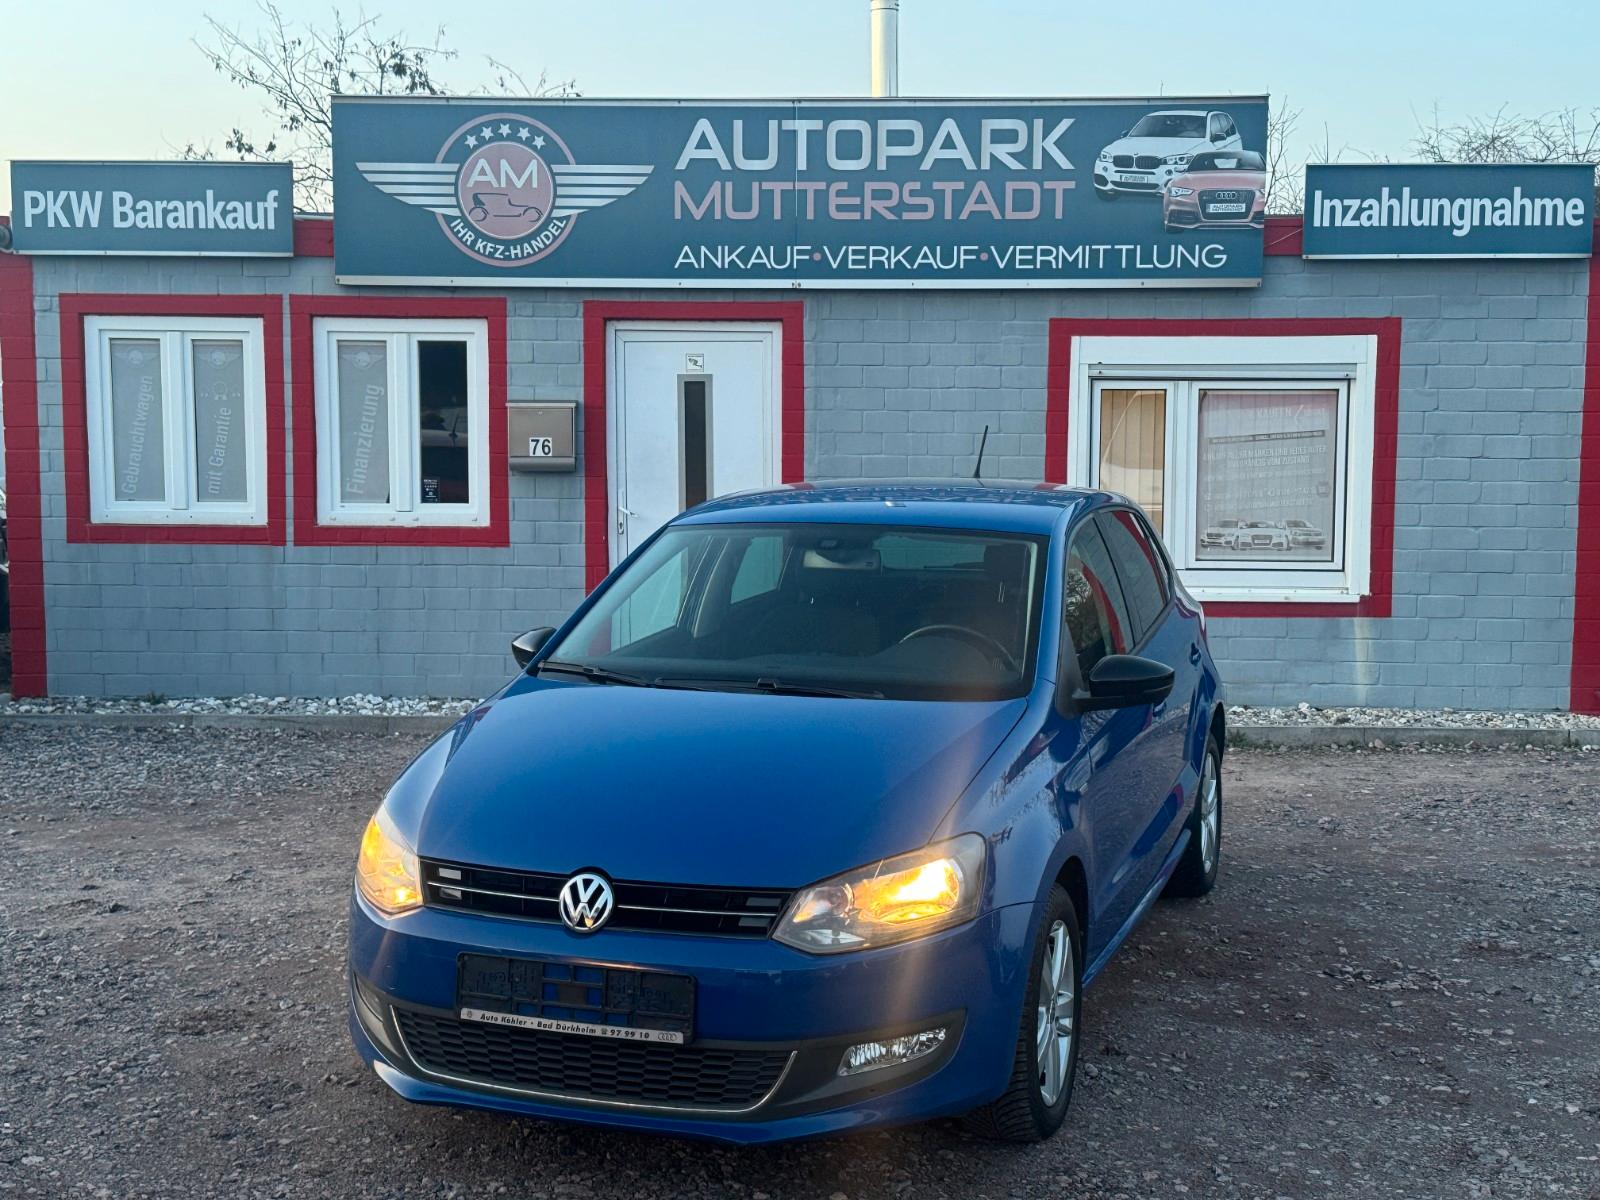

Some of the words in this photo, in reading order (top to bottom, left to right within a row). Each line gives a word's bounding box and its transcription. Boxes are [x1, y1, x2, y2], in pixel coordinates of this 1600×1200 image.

[674, 117, 1076, 171] AUTOPARK
[466, 158, 538, 189] AM
[23, 190, 103, 229] PKW
[112, 189, 279, 230] Barankauf
[673, 180, 1077, 220] MUTTERSTADT
[1312, 186, 1585, 237] Inzahlungnahme
[450, 218, 475, 246] IHR
[475, 218, 567, 259] KFZ-HANDEL
[674, 245, 811, 269] ANKAUF
[823, 245, 979, 269] VERKAUF
[990, 244, 1228, 269] VERMITTLUNG
[121, 375, 155, 495] Gebrauchtwagen
[208, 406, 233, 468] Garantie
[345, 383, 385, 495] Finanzierung
[530, 438, 551, 456] 76
[205, 469, 221, 495] mit
[480, 1013, 499, 1022] Auto
[501, 1016, 527, 1026] Köhler
[537, 1020, 553, 1030] Bad
[610, 1029, 621, 1038] 97
